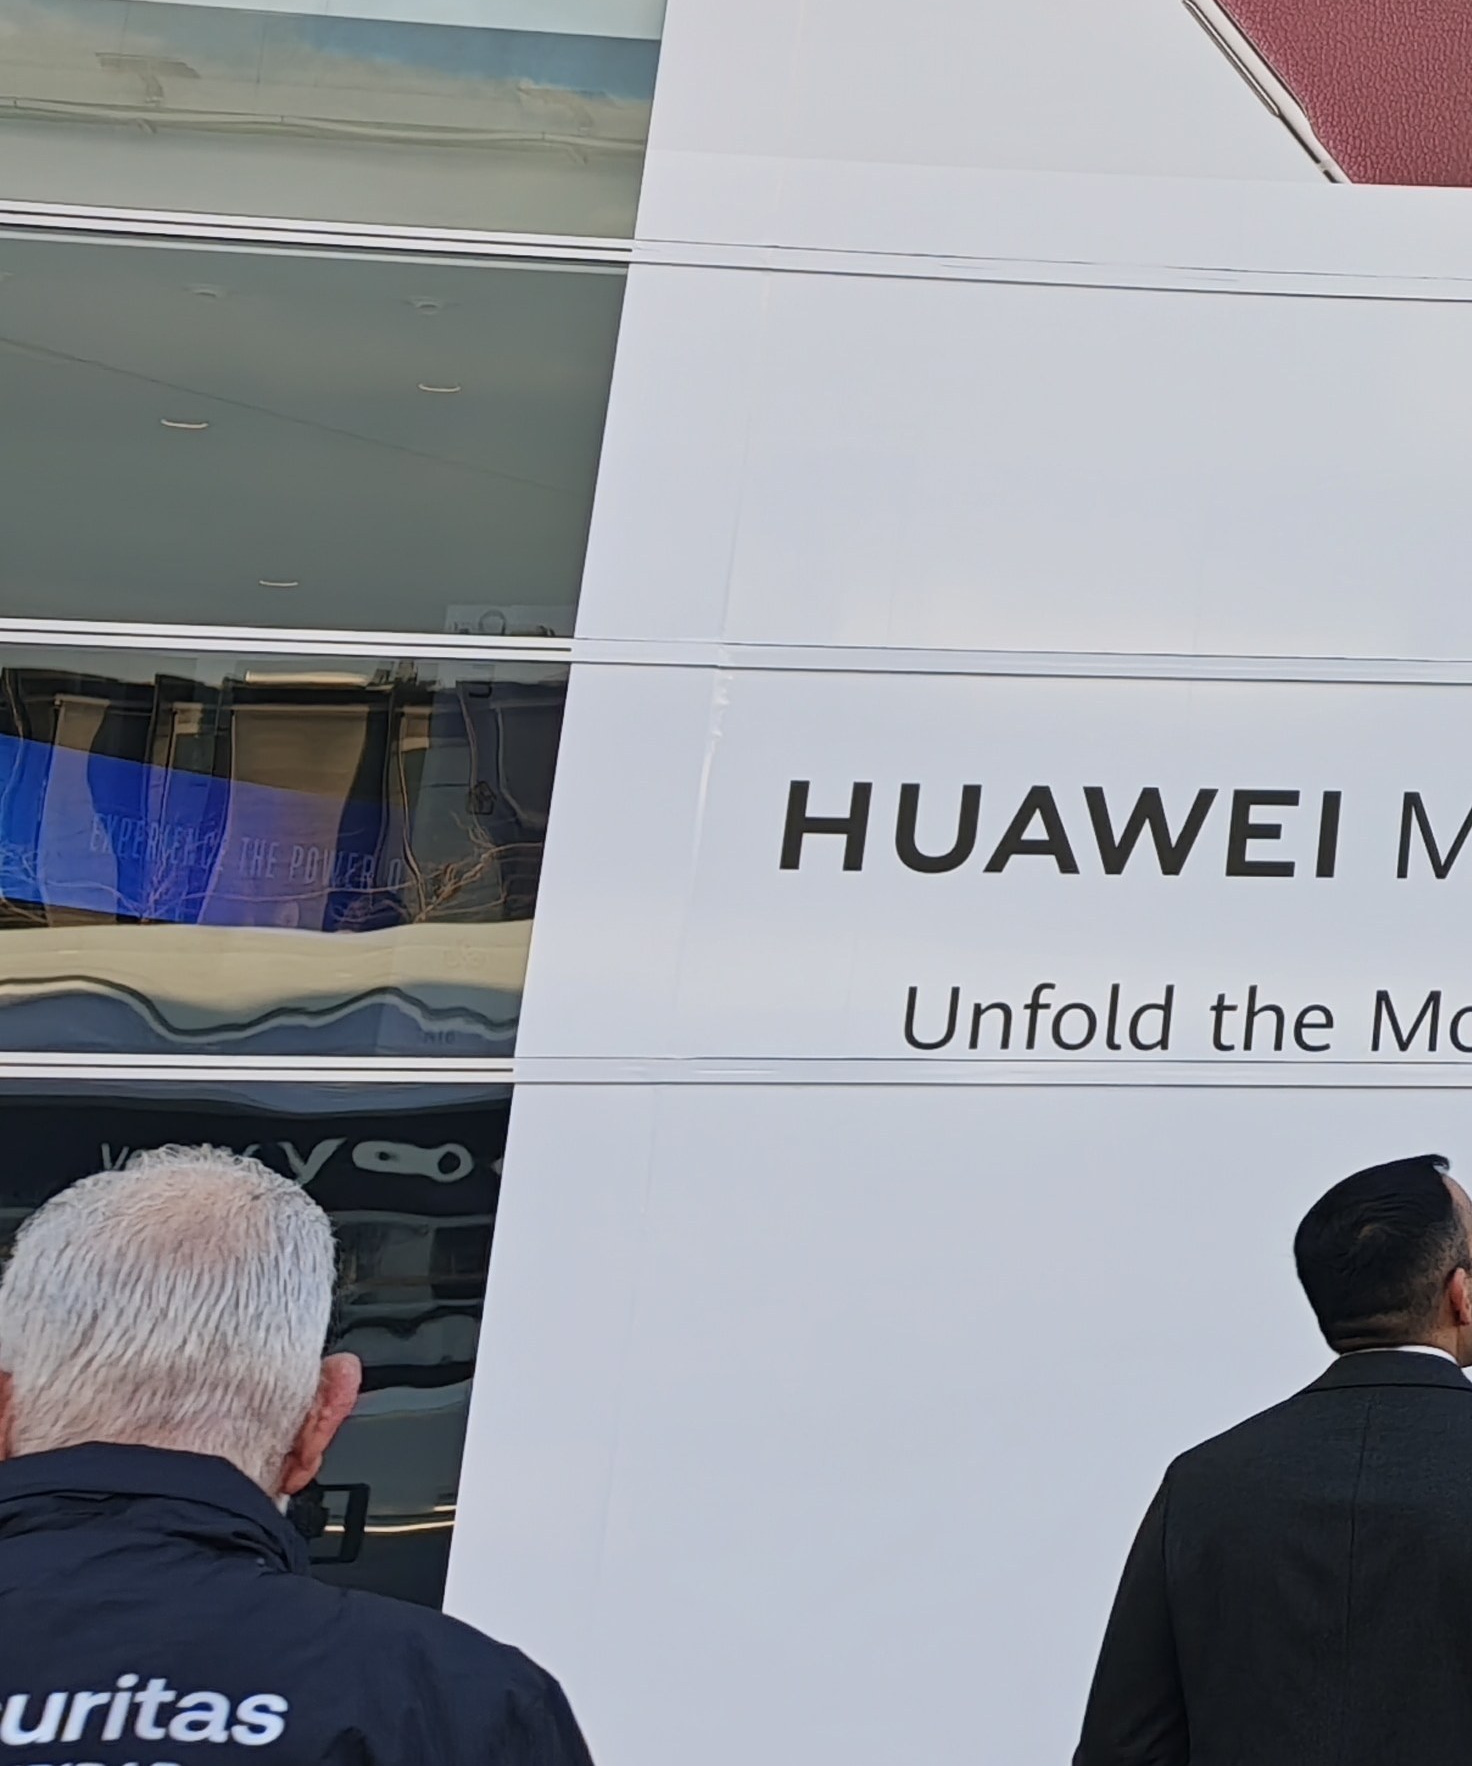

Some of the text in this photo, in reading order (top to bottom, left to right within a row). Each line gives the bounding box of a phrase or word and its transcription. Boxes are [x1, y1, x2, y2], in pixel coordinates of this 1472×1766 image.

[778, 780, 1342, 879] HUAWEI
[904, 982, 1176, 1052] Unfold
[1209, 984, 1335, 1053] the
[0, 1673, 289, 1746] uritas
